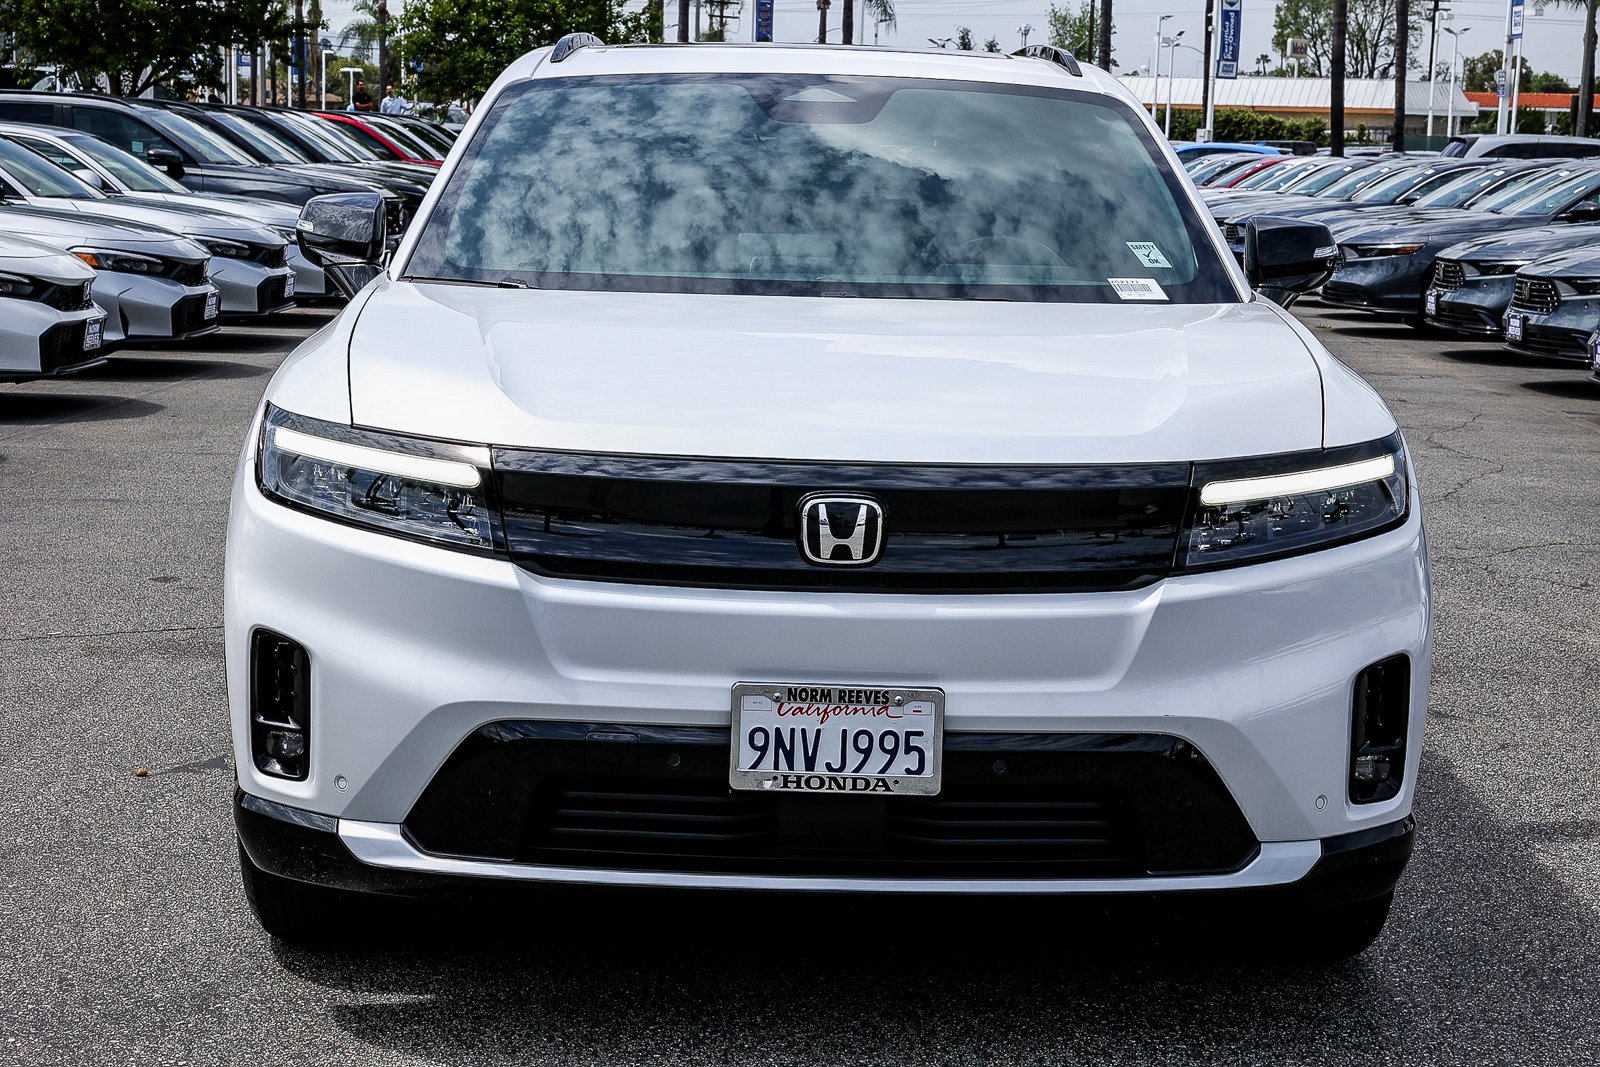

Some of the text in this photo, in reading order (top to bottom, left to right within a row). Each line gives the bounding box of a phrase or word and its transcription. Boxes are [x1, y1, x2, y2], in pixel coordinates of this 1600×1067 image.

[787, 687, 890, 705] NORM REEVES
[777, 702, 904, 724] California
[747, 726, 926, 775] 9NVJ995
[780, 775, 895, 792] HONDA
